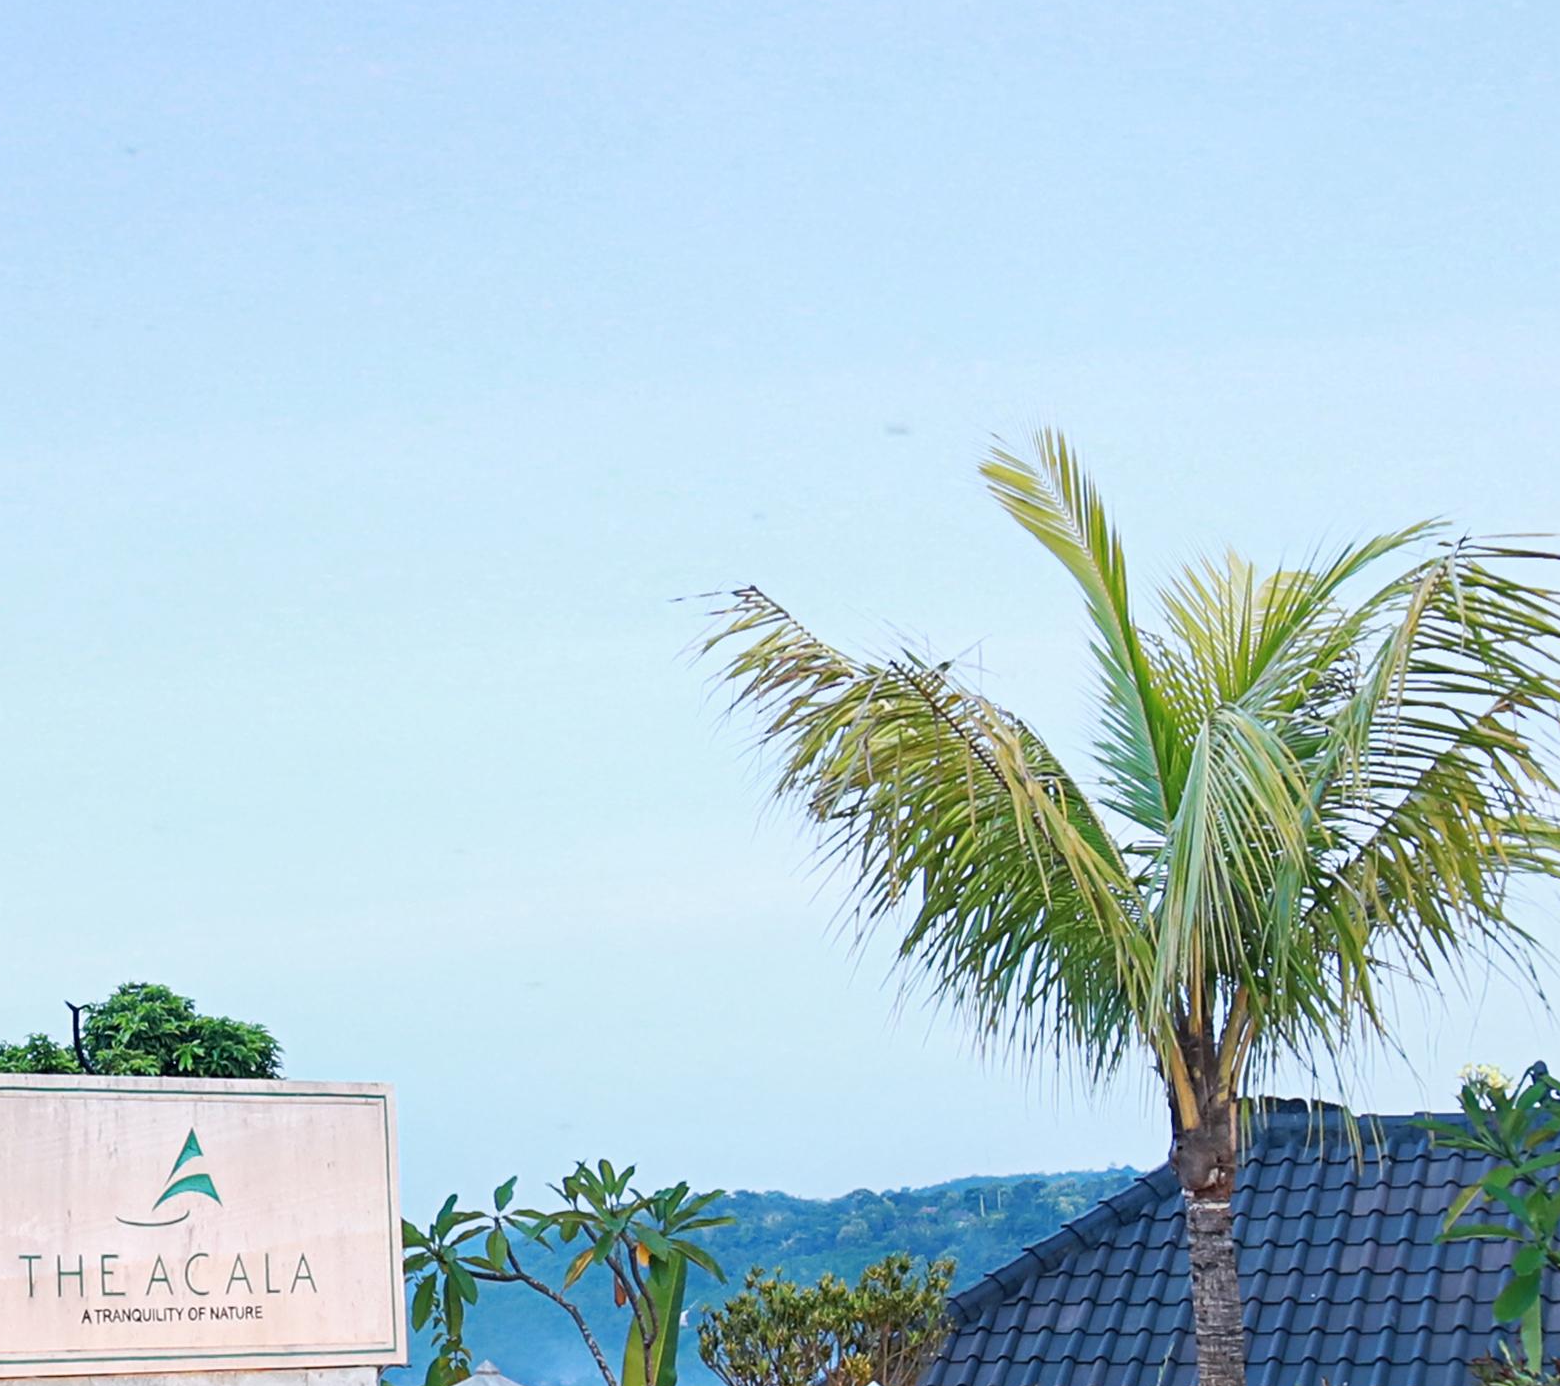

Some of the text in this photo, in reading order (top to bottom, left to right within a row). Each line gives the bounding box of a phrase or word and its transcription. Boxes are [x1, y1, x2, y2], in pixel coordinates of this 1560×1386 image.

[18, 1253, 318, 1298] THE ACALA
[80, 1305, 263, 1324] A TRANQUILITY OF NATURE
